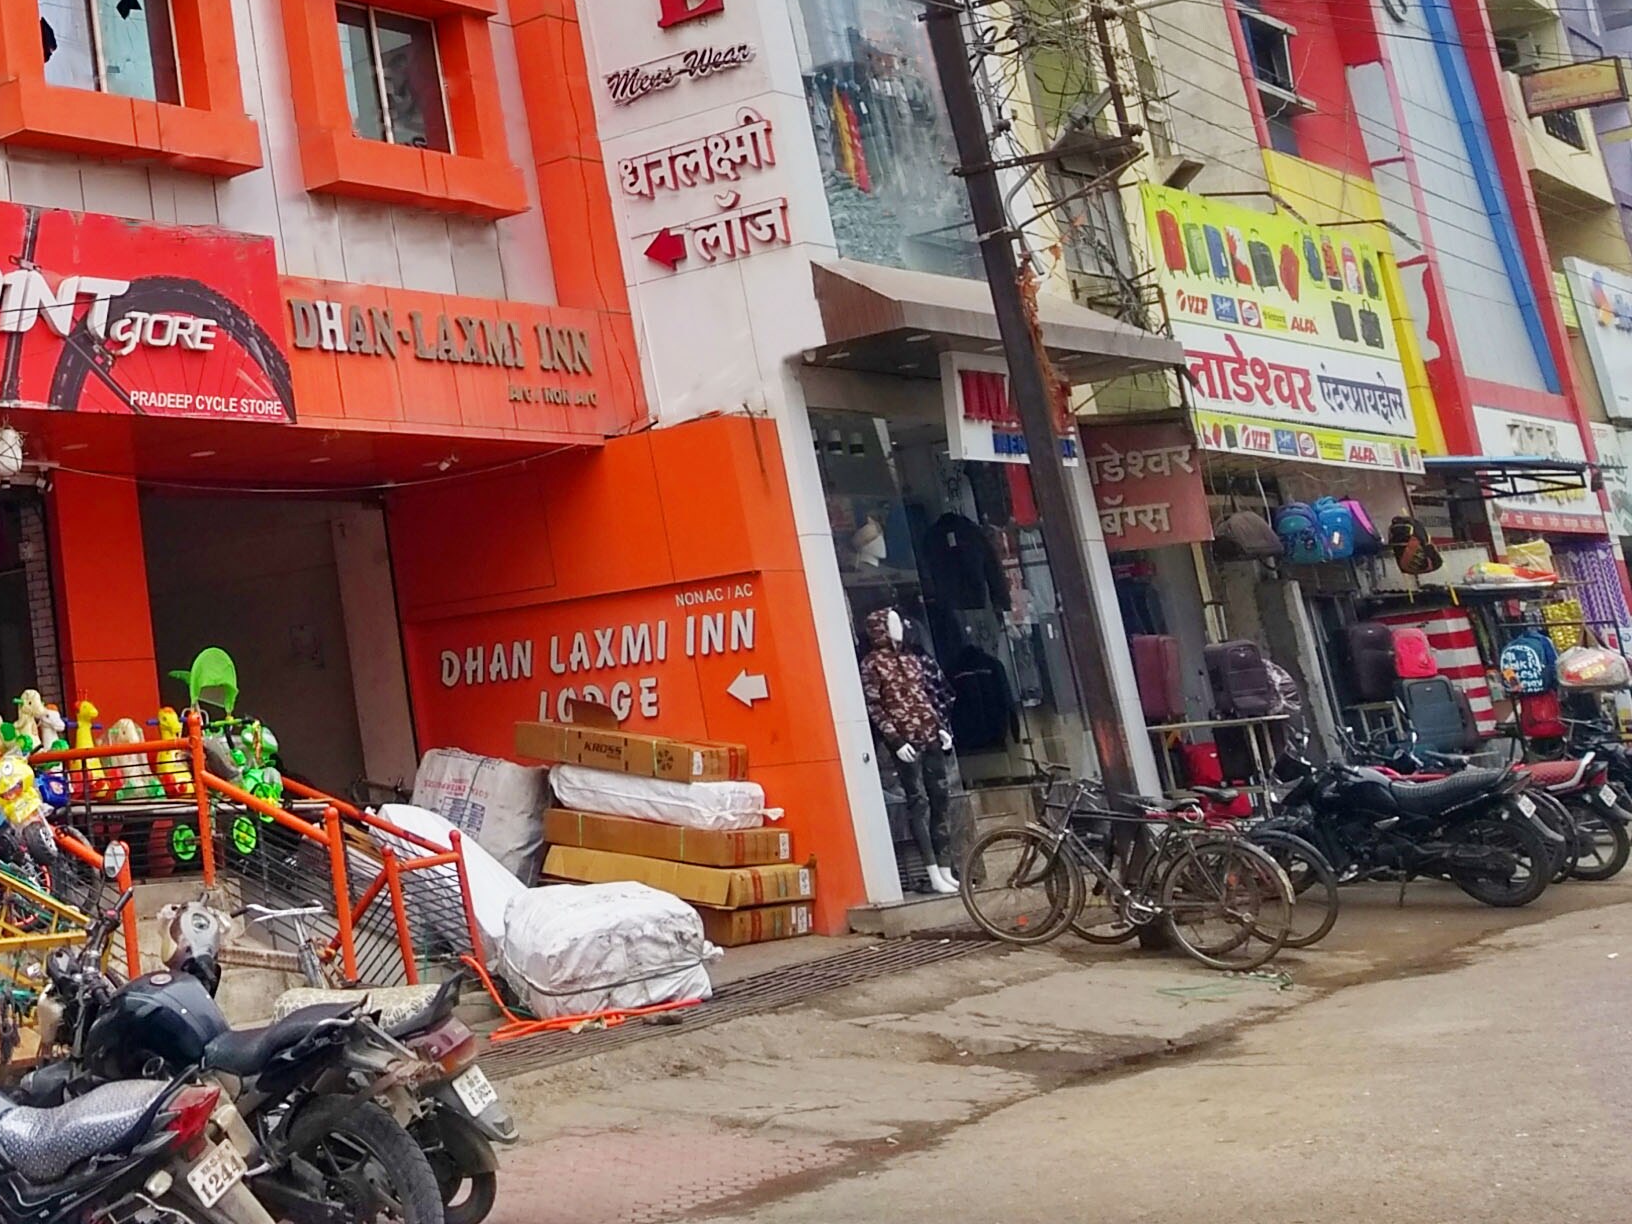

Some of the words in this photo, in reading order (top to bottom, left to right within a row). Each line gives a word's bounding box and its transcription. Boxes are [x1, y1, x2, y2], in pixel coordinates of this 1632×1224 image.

[682, 44, 756, 79] Wear
[617, 106, 776, 200] धनलक्ष्मी
[687, 190, 792, 262] लॉज
[1187, 295, 1209, 315] VIP
[1291, 316, 1319, 335] ALFA
[536, 322, 593, 376] INN
[130, 390, 193, 409] PRADEEP
[195, 394, 238, 413] CYCLE
[240, 398, 283, 416] STORE
[1086, 443, 1196, 486] ाडेश्वर
[1251, 429, 1272, 450] VIP
[1349, 445, 1378, 464] ALFA
[734, 583, 753, 599] AC
[440, 639, 534, 688] DHAN
[549, 619, 667, 675] LAXMI
[685, 608, 756, 658] INN
[584, 741, 623, 756] KROSS
[201, 1155, 243, 1201] 1244
